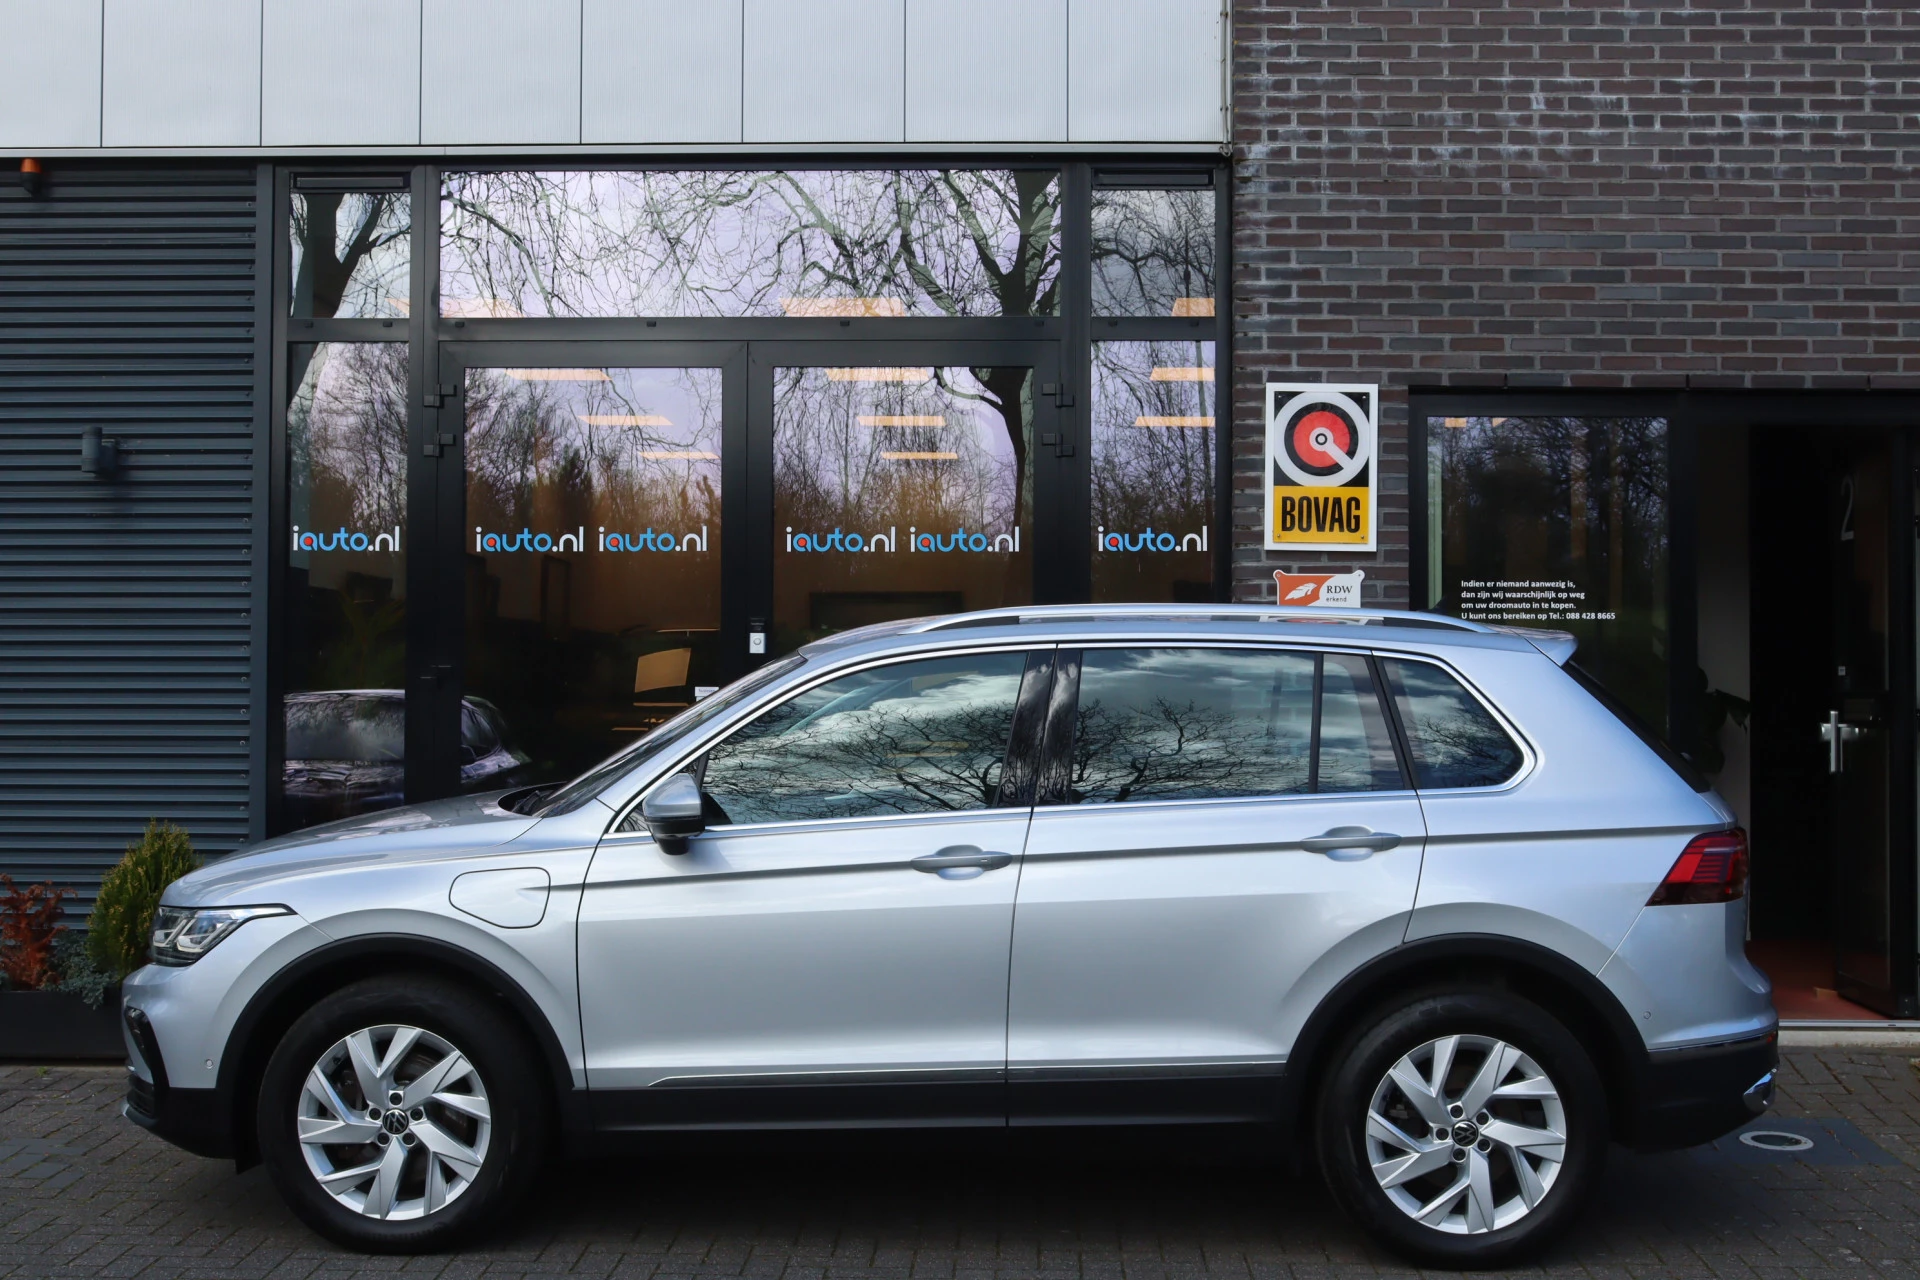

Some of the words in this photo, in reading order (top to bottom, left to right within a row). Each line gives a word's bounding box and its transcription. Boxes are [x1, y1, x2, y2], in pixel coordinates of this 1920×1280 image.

[1281, 496, 1361, 533] BOVAG
[1841, 475, 1854, 541] 2
[293, 525, 400, 552] iauto.nl
[475, 526, 584, 553] iauto.nl
[598, 525, 707, 552] iauto.nl
[786, 526, 896, 553] iauto.nl
[910, 526, 1020, 553] iauto.nl
[1097, 525, 1208, 552] iauto.nl
[1326, 585, 1353, 594] RDW
[1461, 580, 1485, 588] Indien
[1496, 580, 1529, 588] niemand
[1531, 580, 1566, 590] aanwezig
[1567, 580, 1576, 590] is,
[1477, 591, 1490, 600] zijn
[1492, 591, 1503, 600] wij
[1505, 591, 1556, 600] waarschijnlijk
[1558, 592, 1567, 600] op
[1569, 592, 1585, 600] weg
[1488, 601, 1531, 609] droomauto
[1551, 602, 1576, 611] kopen.
